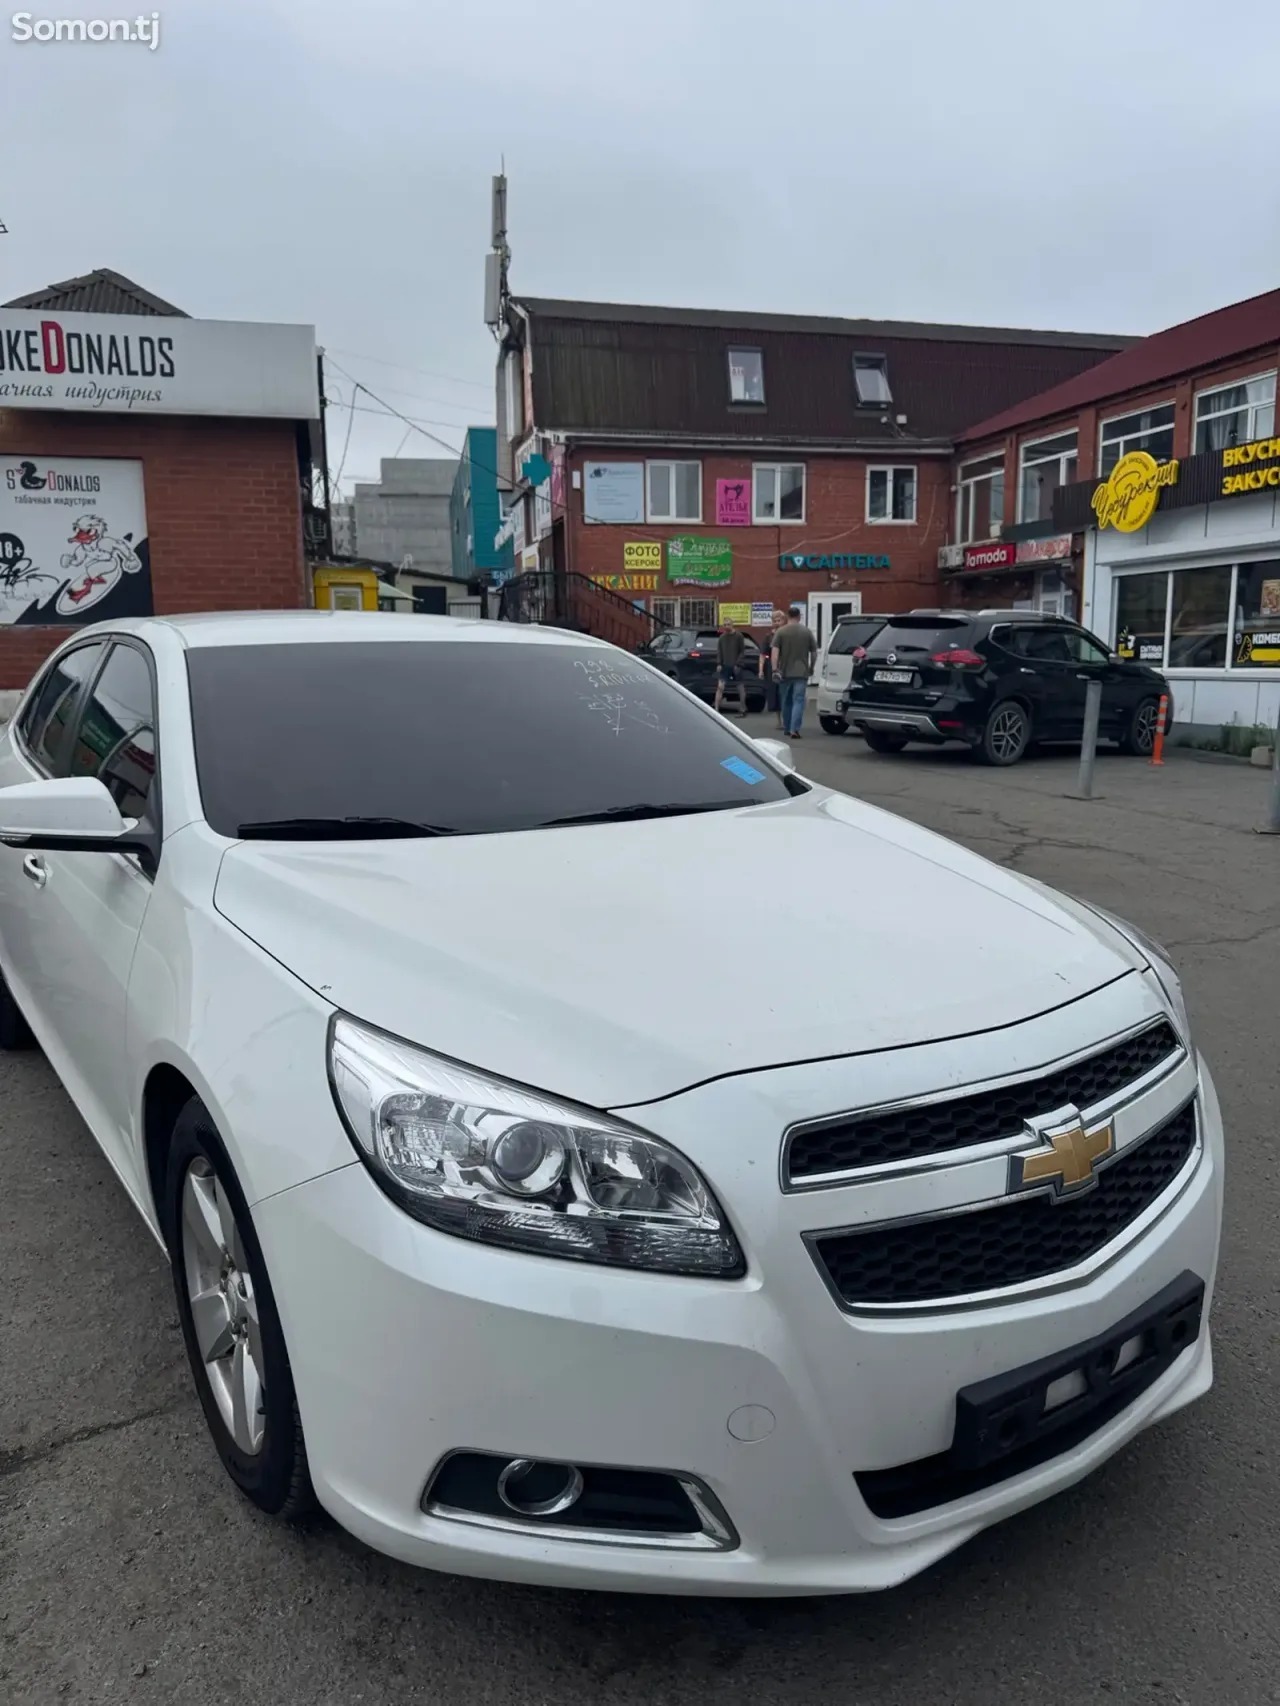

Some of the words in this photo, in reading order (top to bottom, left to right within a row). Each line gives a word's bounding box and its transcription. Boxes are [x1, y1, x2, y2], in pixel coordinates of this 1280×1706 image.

[0, 381, 53, 397] ачная
[65, 381, 163, 408] индустрия
[14, 495, 52, 505] табачная
[53, 496, 97, 507] индустрия
[625, 546, 660, 557] ФОТО
[966, 548, 1007, 567] lamoda
[625, 559, 660, 567] КСЕРОКС
